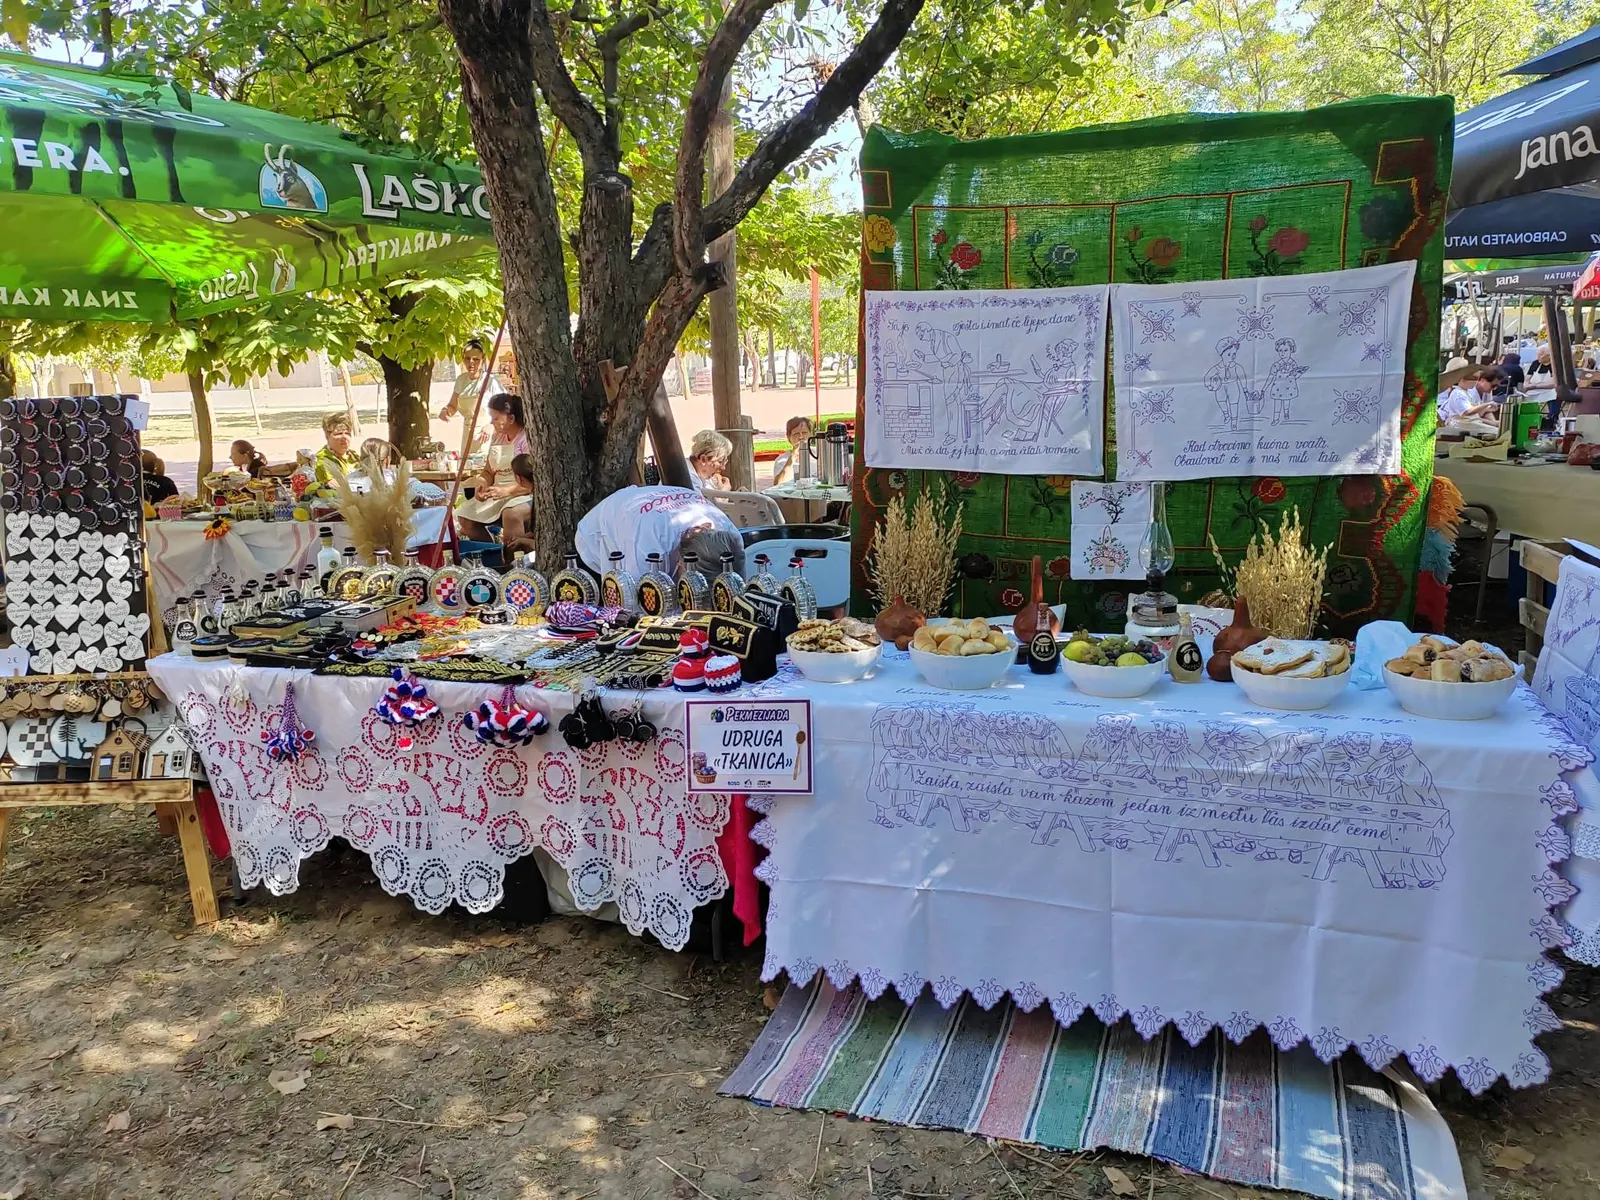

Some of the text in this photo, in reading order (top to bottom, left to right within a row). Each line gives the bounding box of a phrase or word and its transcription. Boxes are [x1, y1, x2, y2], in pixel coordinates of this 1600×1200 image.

[0, 136, 130, 176] ERA.
[1543, 270, 1581, 281] NATURAL
[725, 706, 789, 722] PEKMEZIJADA
[722, 730, 783, 748] UDRUGA
[1019, 788, 1057, 802] vam
[1119, 798, 1173, 816] jedan
